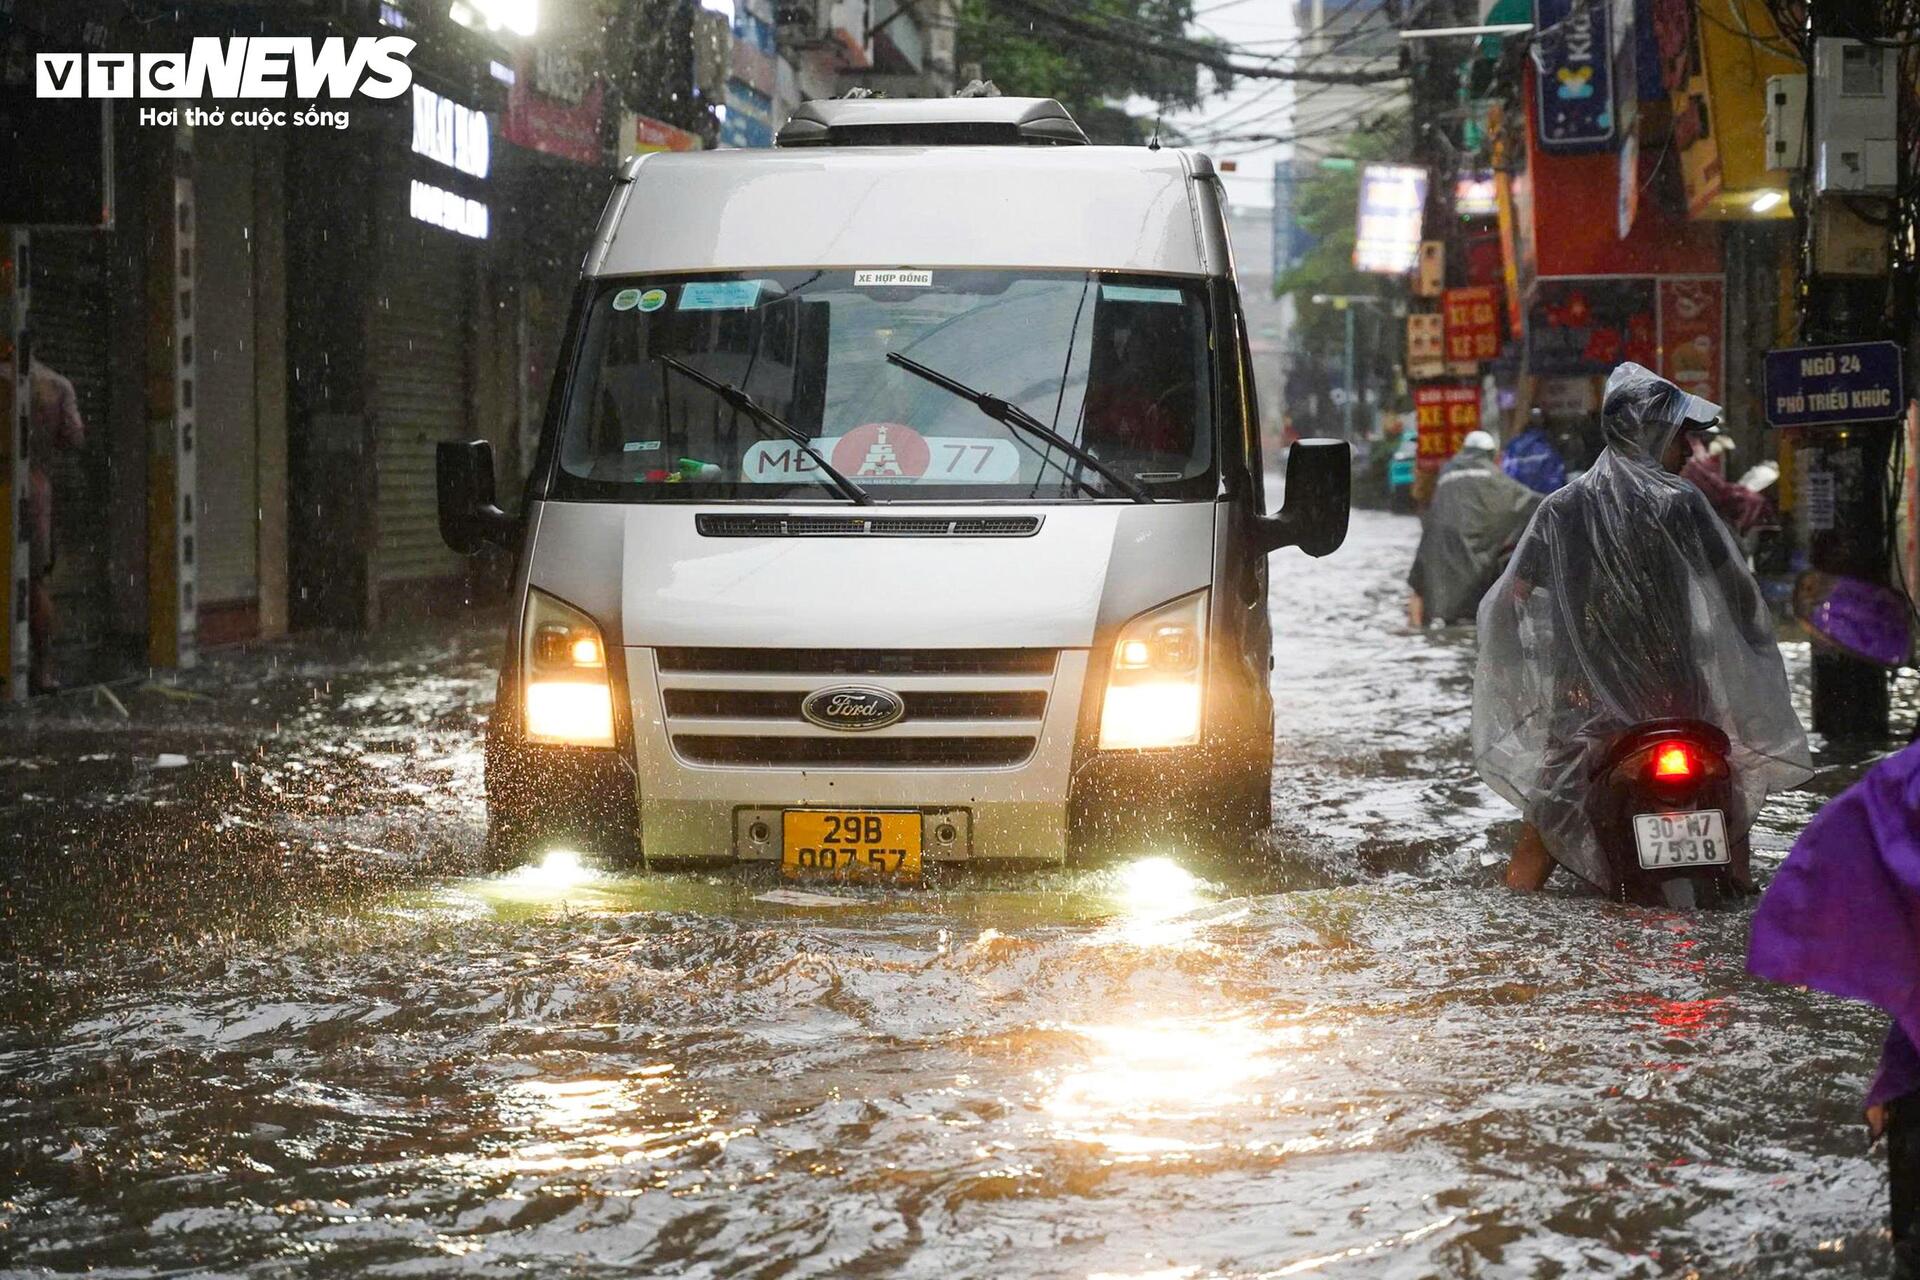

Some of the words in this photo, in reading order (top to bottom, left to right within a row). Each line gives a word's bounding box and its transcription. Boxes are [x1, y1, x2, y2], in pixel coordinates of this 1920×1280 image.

[858, 274, 873, 282] XE
[875, 273, 896, 284] HỢP
[1801, 352, 1835, 377] NGÕ
[1840, 354, 1861, 374] 24
[1776, 386, 1804, 414] PHỐ
[1851, 383, 1891, 409] KHÚC
[943, 444, 994, 474] 77
[827, 694, 879, 716] Ford
[823, 816, 882, 844] 29B
[1650, 839, 1717, 864] 7538
